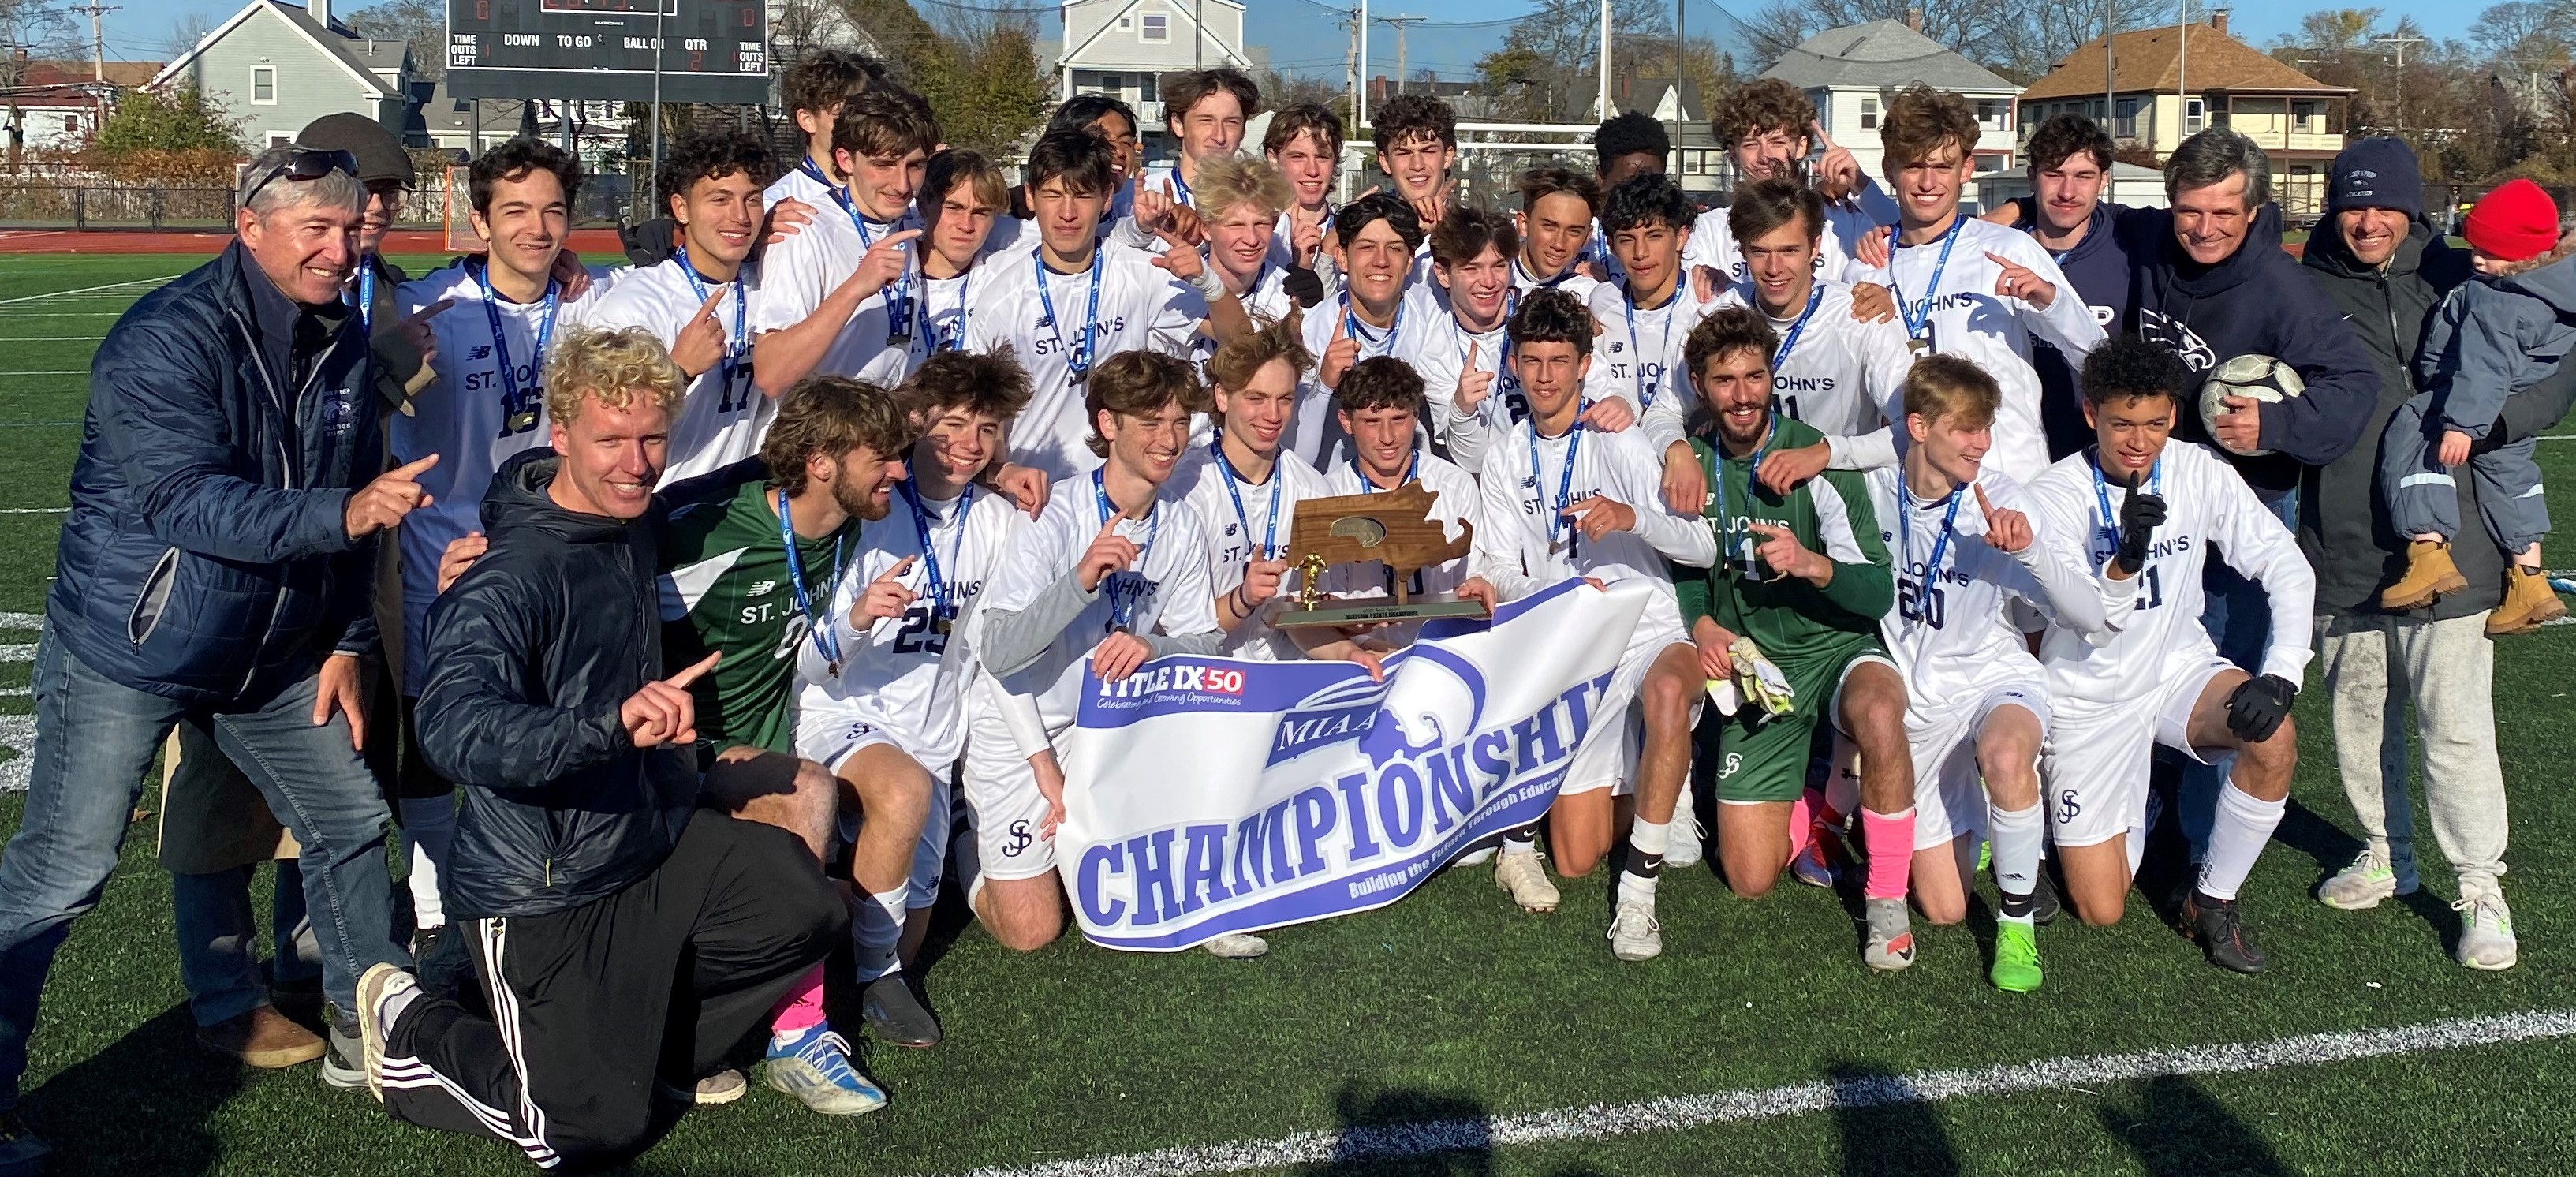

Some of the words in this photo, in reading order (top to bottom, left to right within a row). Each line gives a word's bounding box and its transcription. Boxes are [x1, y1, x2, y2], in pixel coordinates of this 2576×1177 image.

[453, 34, 476, 44] TIME
[504, 34, 539, 46] DOWN
[557, 35, 572, 47] TO
[575, 35, 592, 47] GO
[624, 37, 648, 49] BALL
[685, 39, 707, 50] QTR
[739, 42, 761, 52] TIME
[450, 44, 476, 55] OUTS
[739, 52, 764, 62] OUTS
[453, 55, 476, 65] LEFT
[740, 62, 762, 72] LEFT
[1611, 363, 1632, 379] ST.
[465, 370, 497, 391] ST.
[1775, 376, 1835, 392] OHN'S
[2145, 535, 2190, 561] HN'S
[1740, 538, 1760, 581] 1
[1897, 577, 1945, 630] 20
[741, 603, 775, 624] ST.
[892, 602, 960, 656] 25
[1096, 697, 1141, 711] Celebrating
[1154, 693, 1185, 704] Growing
[1186, 691, 1242, 706] Opportunities
[1278, 708, 1378, 752] MIAA
[1348, 869, 1408, 899] Building
[1407, 859, 1430, 878] the
[1431, 828, 1466, 863] Future
[1467, 790, 1518, 830] Through
